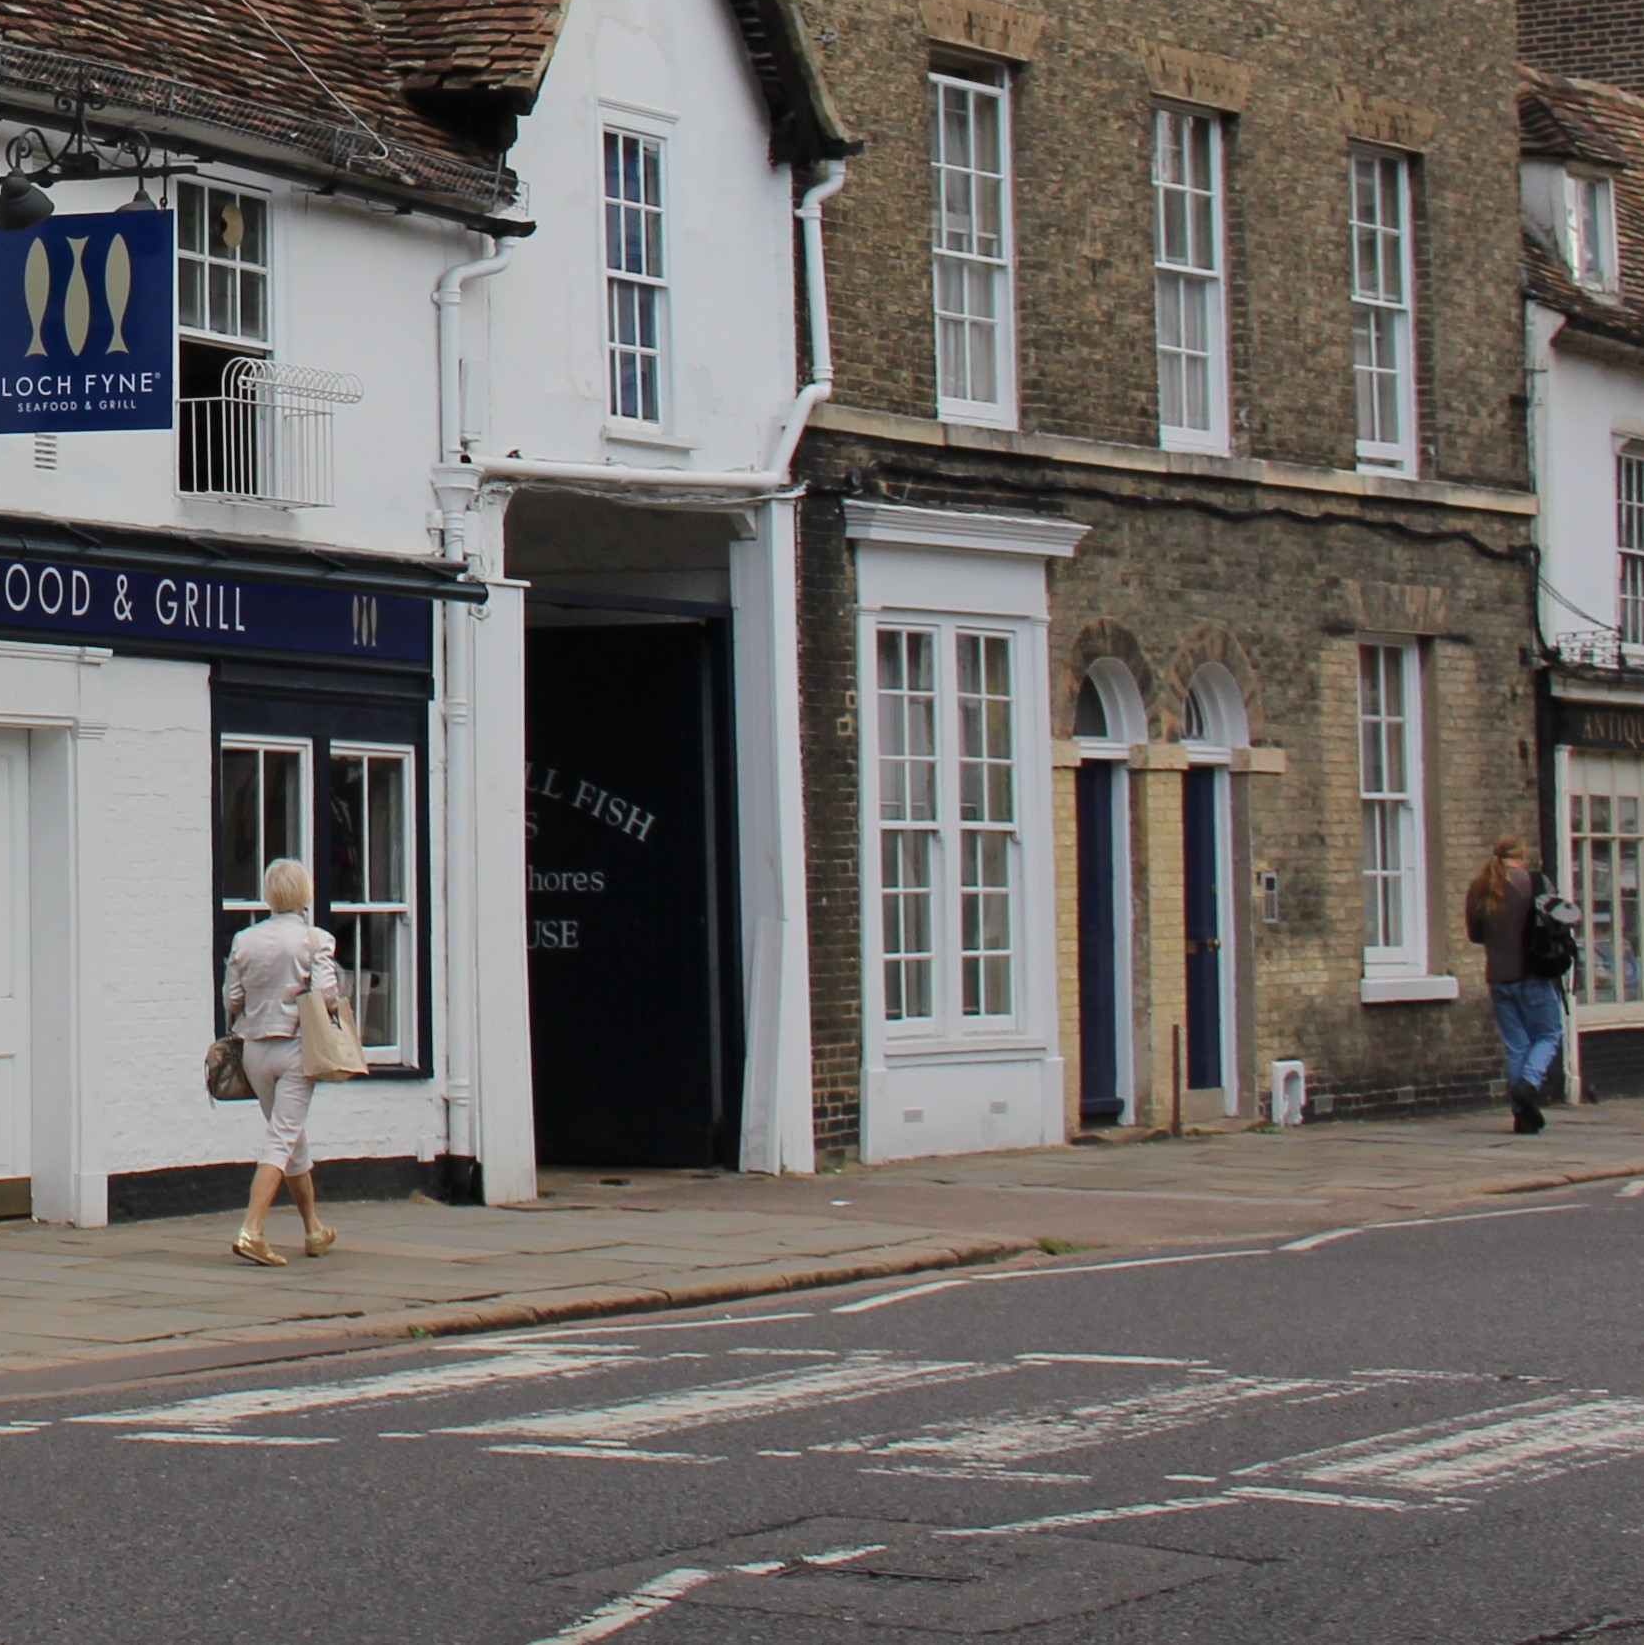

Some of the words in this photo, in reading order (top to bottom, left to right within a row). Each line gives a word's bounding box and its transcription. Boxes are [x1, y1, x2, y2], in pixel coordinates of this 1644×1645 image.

[1, 375, 72, 397] LOCH
[17, 400, 77, 413] SEAFOOD
[84, 400, 92, 410] &
[99, 399, 137, 411] GRILL
[114, 573, 133, 622] &
[155, 578, 246, 632] GRILL
[525, 761, 562, 799] LL
[571, 779, 656, 843] FISH
[527, 864, 605, 892] hores
[526, 919, 580, 949] USE
